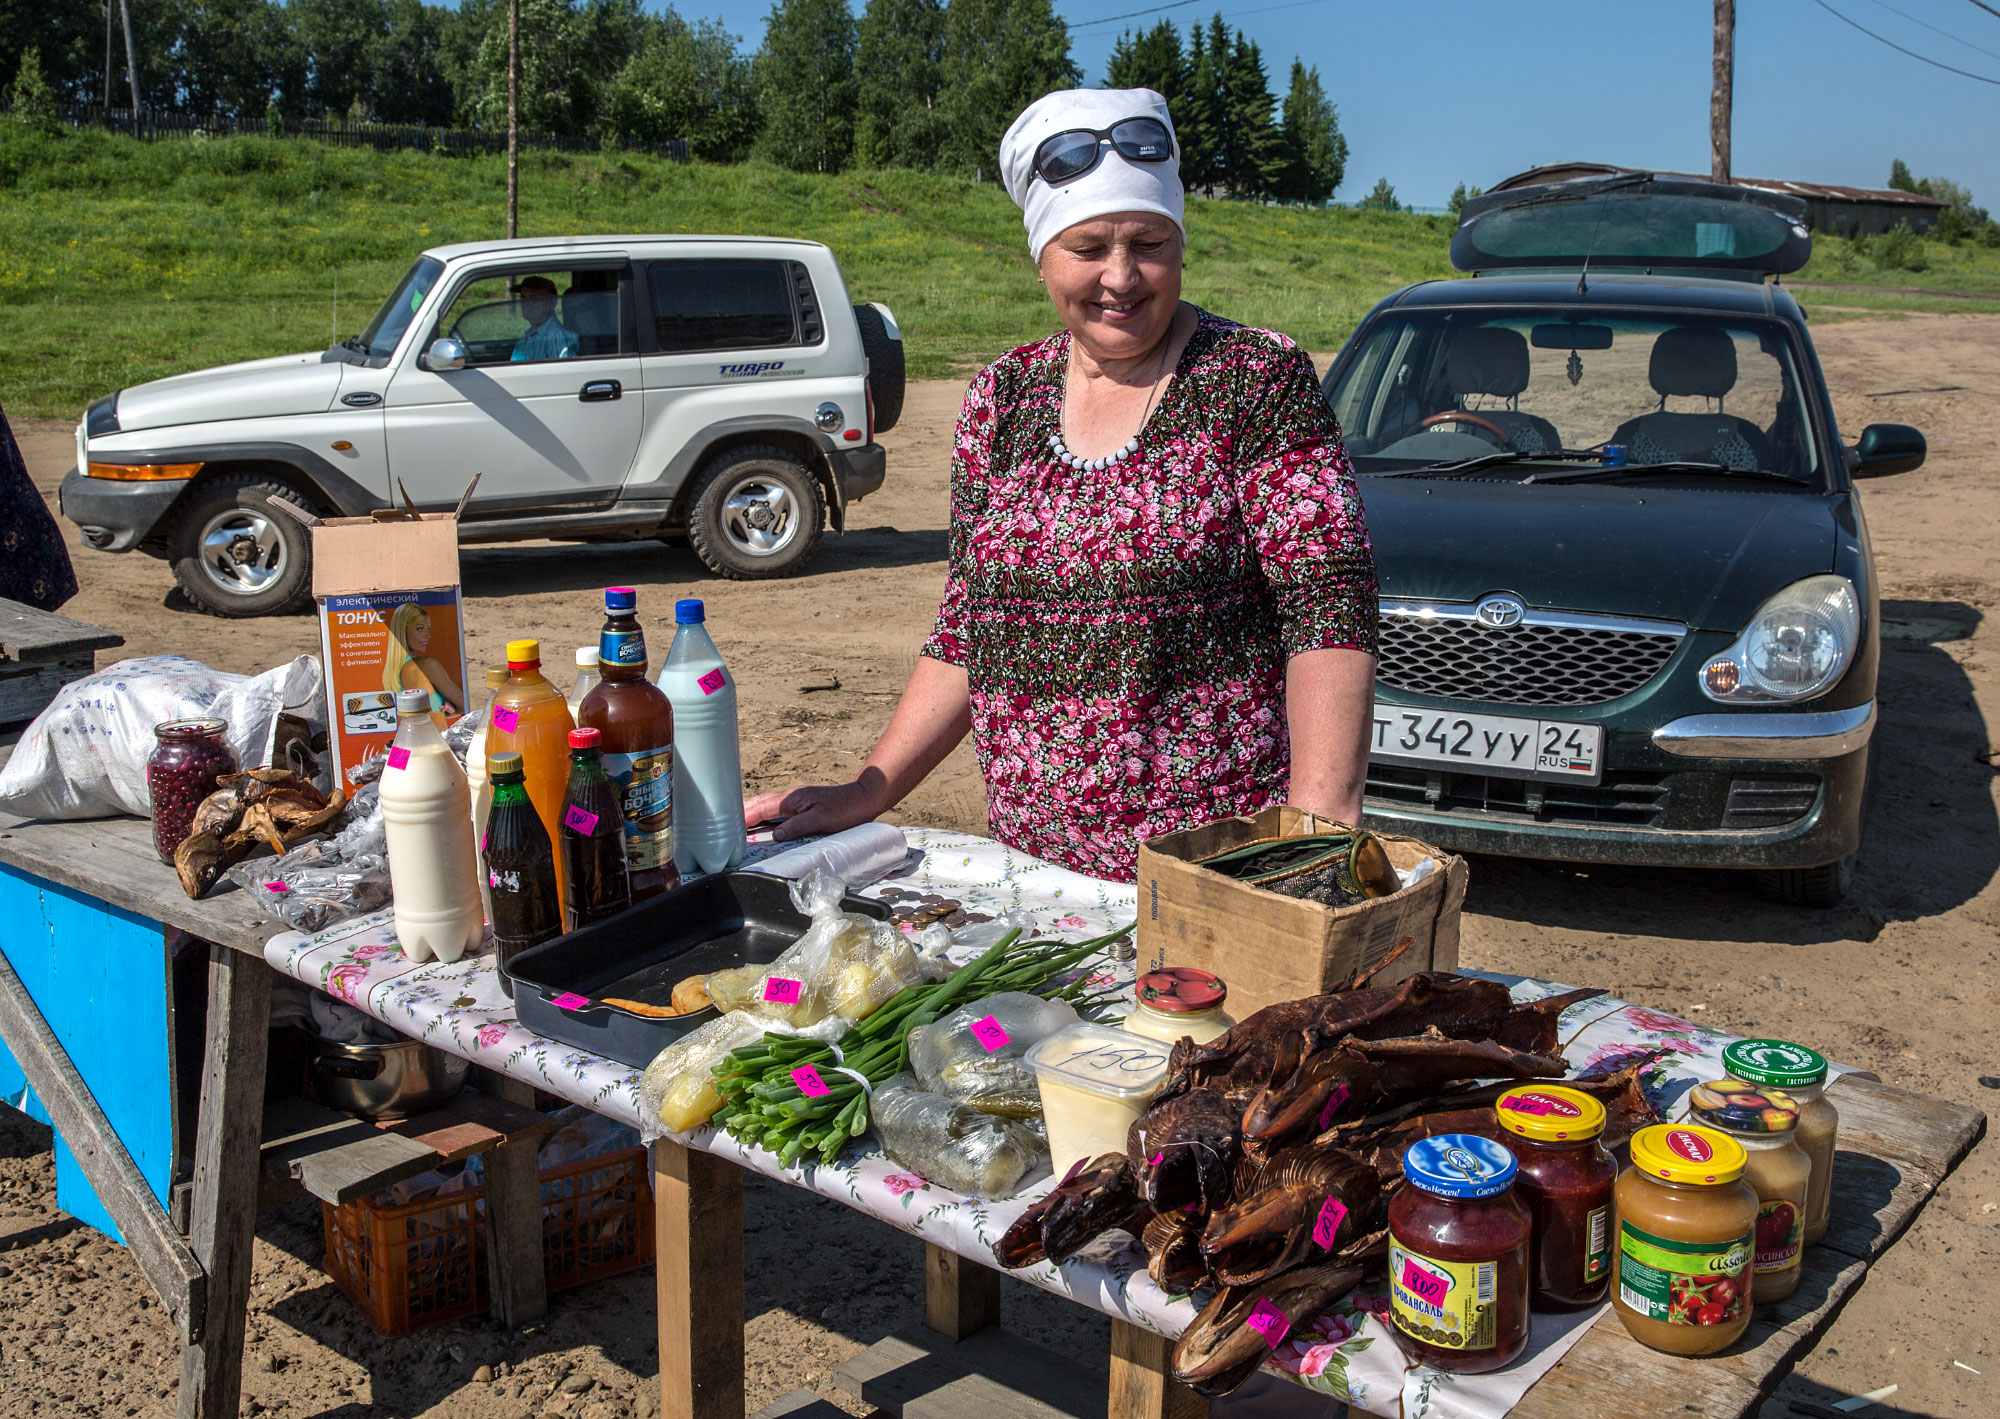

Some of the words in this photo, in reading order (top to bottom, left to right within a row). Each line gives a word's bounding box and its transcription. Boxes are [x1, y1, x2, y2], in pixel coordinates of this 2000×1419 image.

[719, 361, 785, 376] TURBO
[336, 592, 419, 607] электрический
[339, 631, 386, 639] Максимально
[340, 640, 380, 649] эффективен
[346, 658, 382, 667] фитнесом!
[703, 675, 718, 690] 60
[1543, 727, 1583, 757] 24
[1539, 755, 1568, 768] RUS
[771, 979, 791, 996] 50
[981, 1026, 1001, 1038] 50
[1056, 1044, 1166, 1072] 150
[1393, 1282, 1443, 1318] ПРОВАНСАЛЬ
